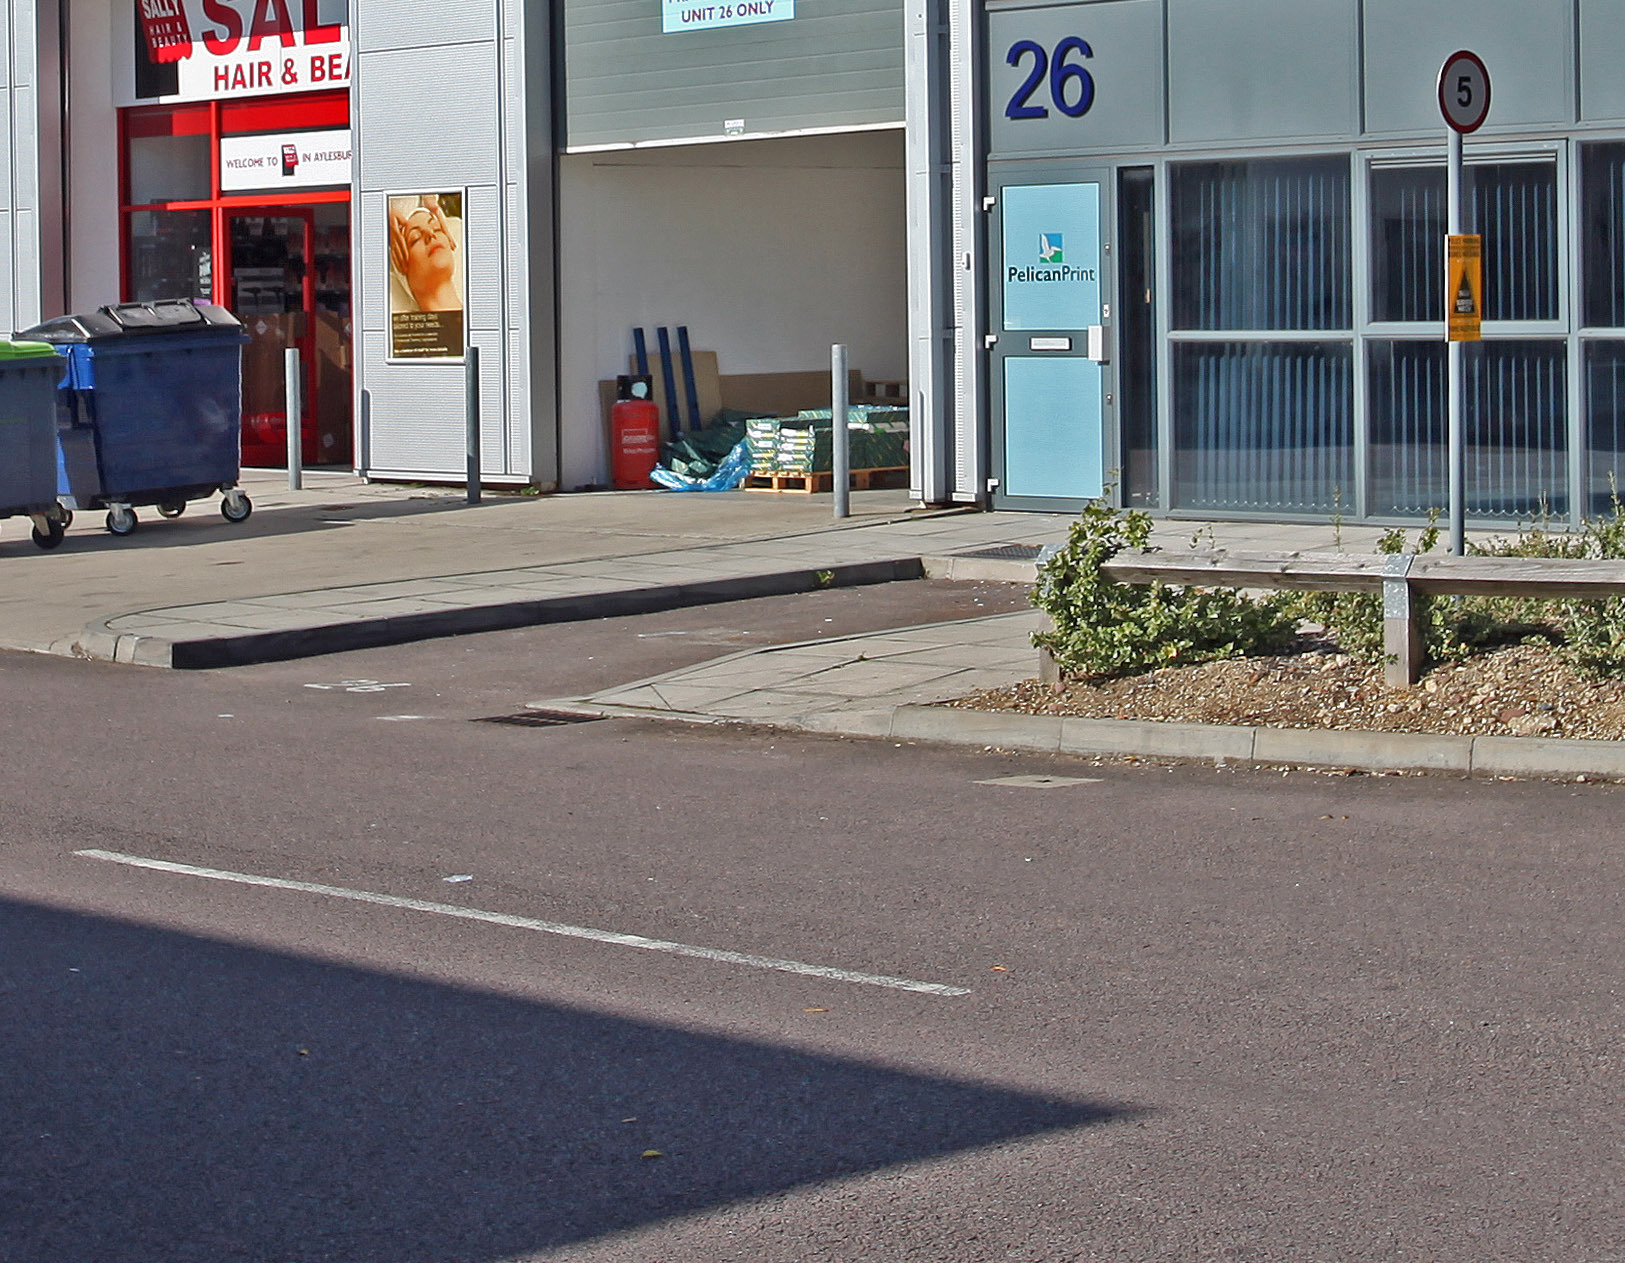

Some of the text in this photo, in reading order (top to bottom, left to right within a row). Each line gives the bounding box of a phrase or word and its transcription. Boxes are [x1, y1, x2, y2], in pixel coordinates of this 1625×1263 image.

[682, 0, 774, 23] UNIT 26 ONLY
[151, 34, 188, 49] BEAUTY
[214, 61, 273, 92] HAIR
[281, 58, 298, 85] &
[1005, 36, 1095, 121] 26
[1457, 76, 1472, 108] 5
[226, 157, 264, 168] WELCOME
[267, 156, 278, 167] TO
[302, 152, 311, 162] IN
[1008, 265, 1095, 282] PelicanPrint
